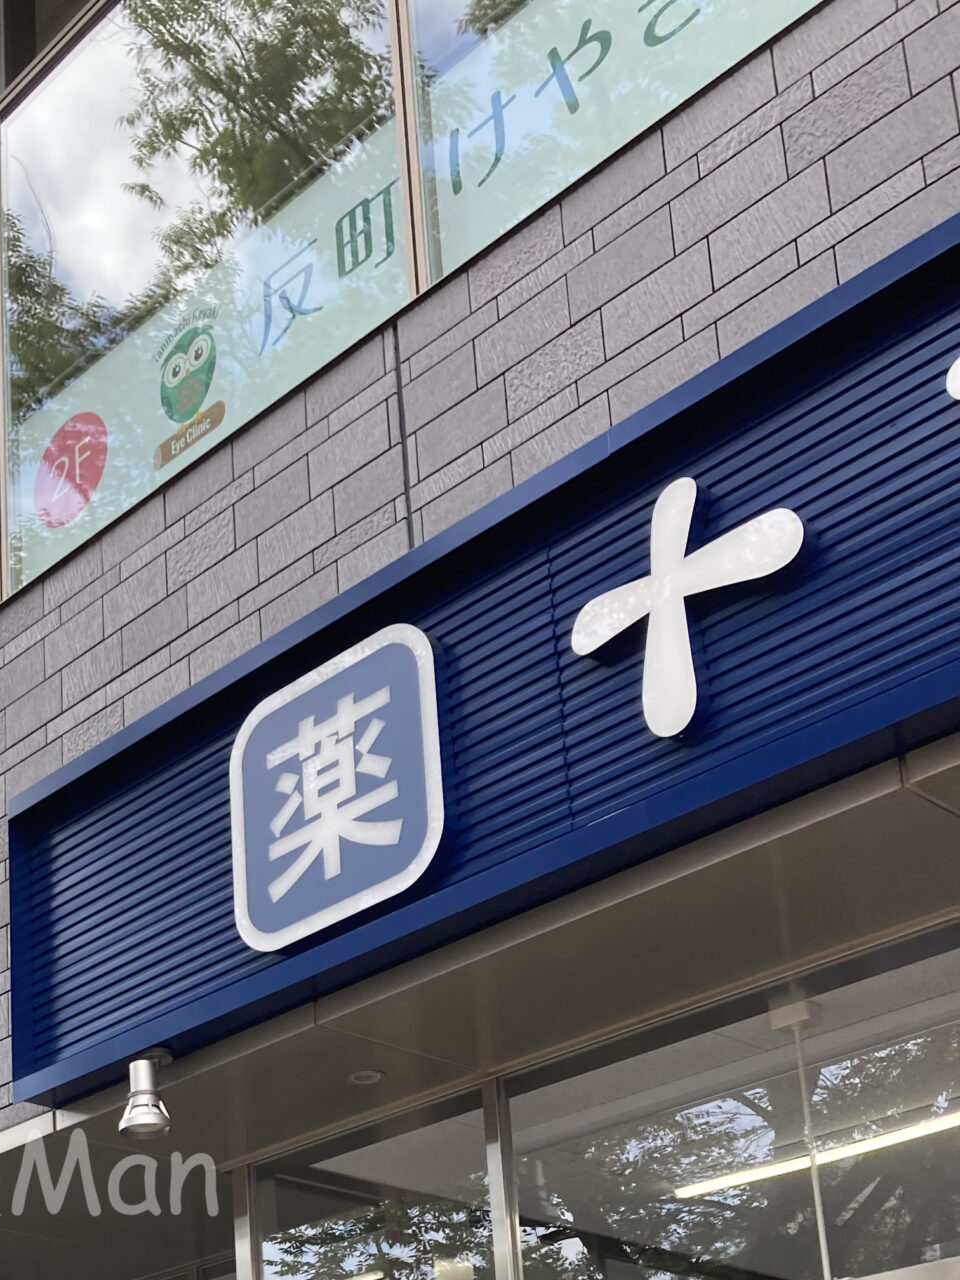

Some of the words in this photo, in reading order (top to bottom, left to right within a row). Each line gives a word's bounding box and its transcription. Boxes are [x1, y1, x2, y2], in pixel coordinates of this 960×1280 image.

[49, 435, 93, 503] 2F
[171, 434, 186, 456] Eye
[187, 416, 212, 444] Clinic
[266, 685, 404, 904] 薬
